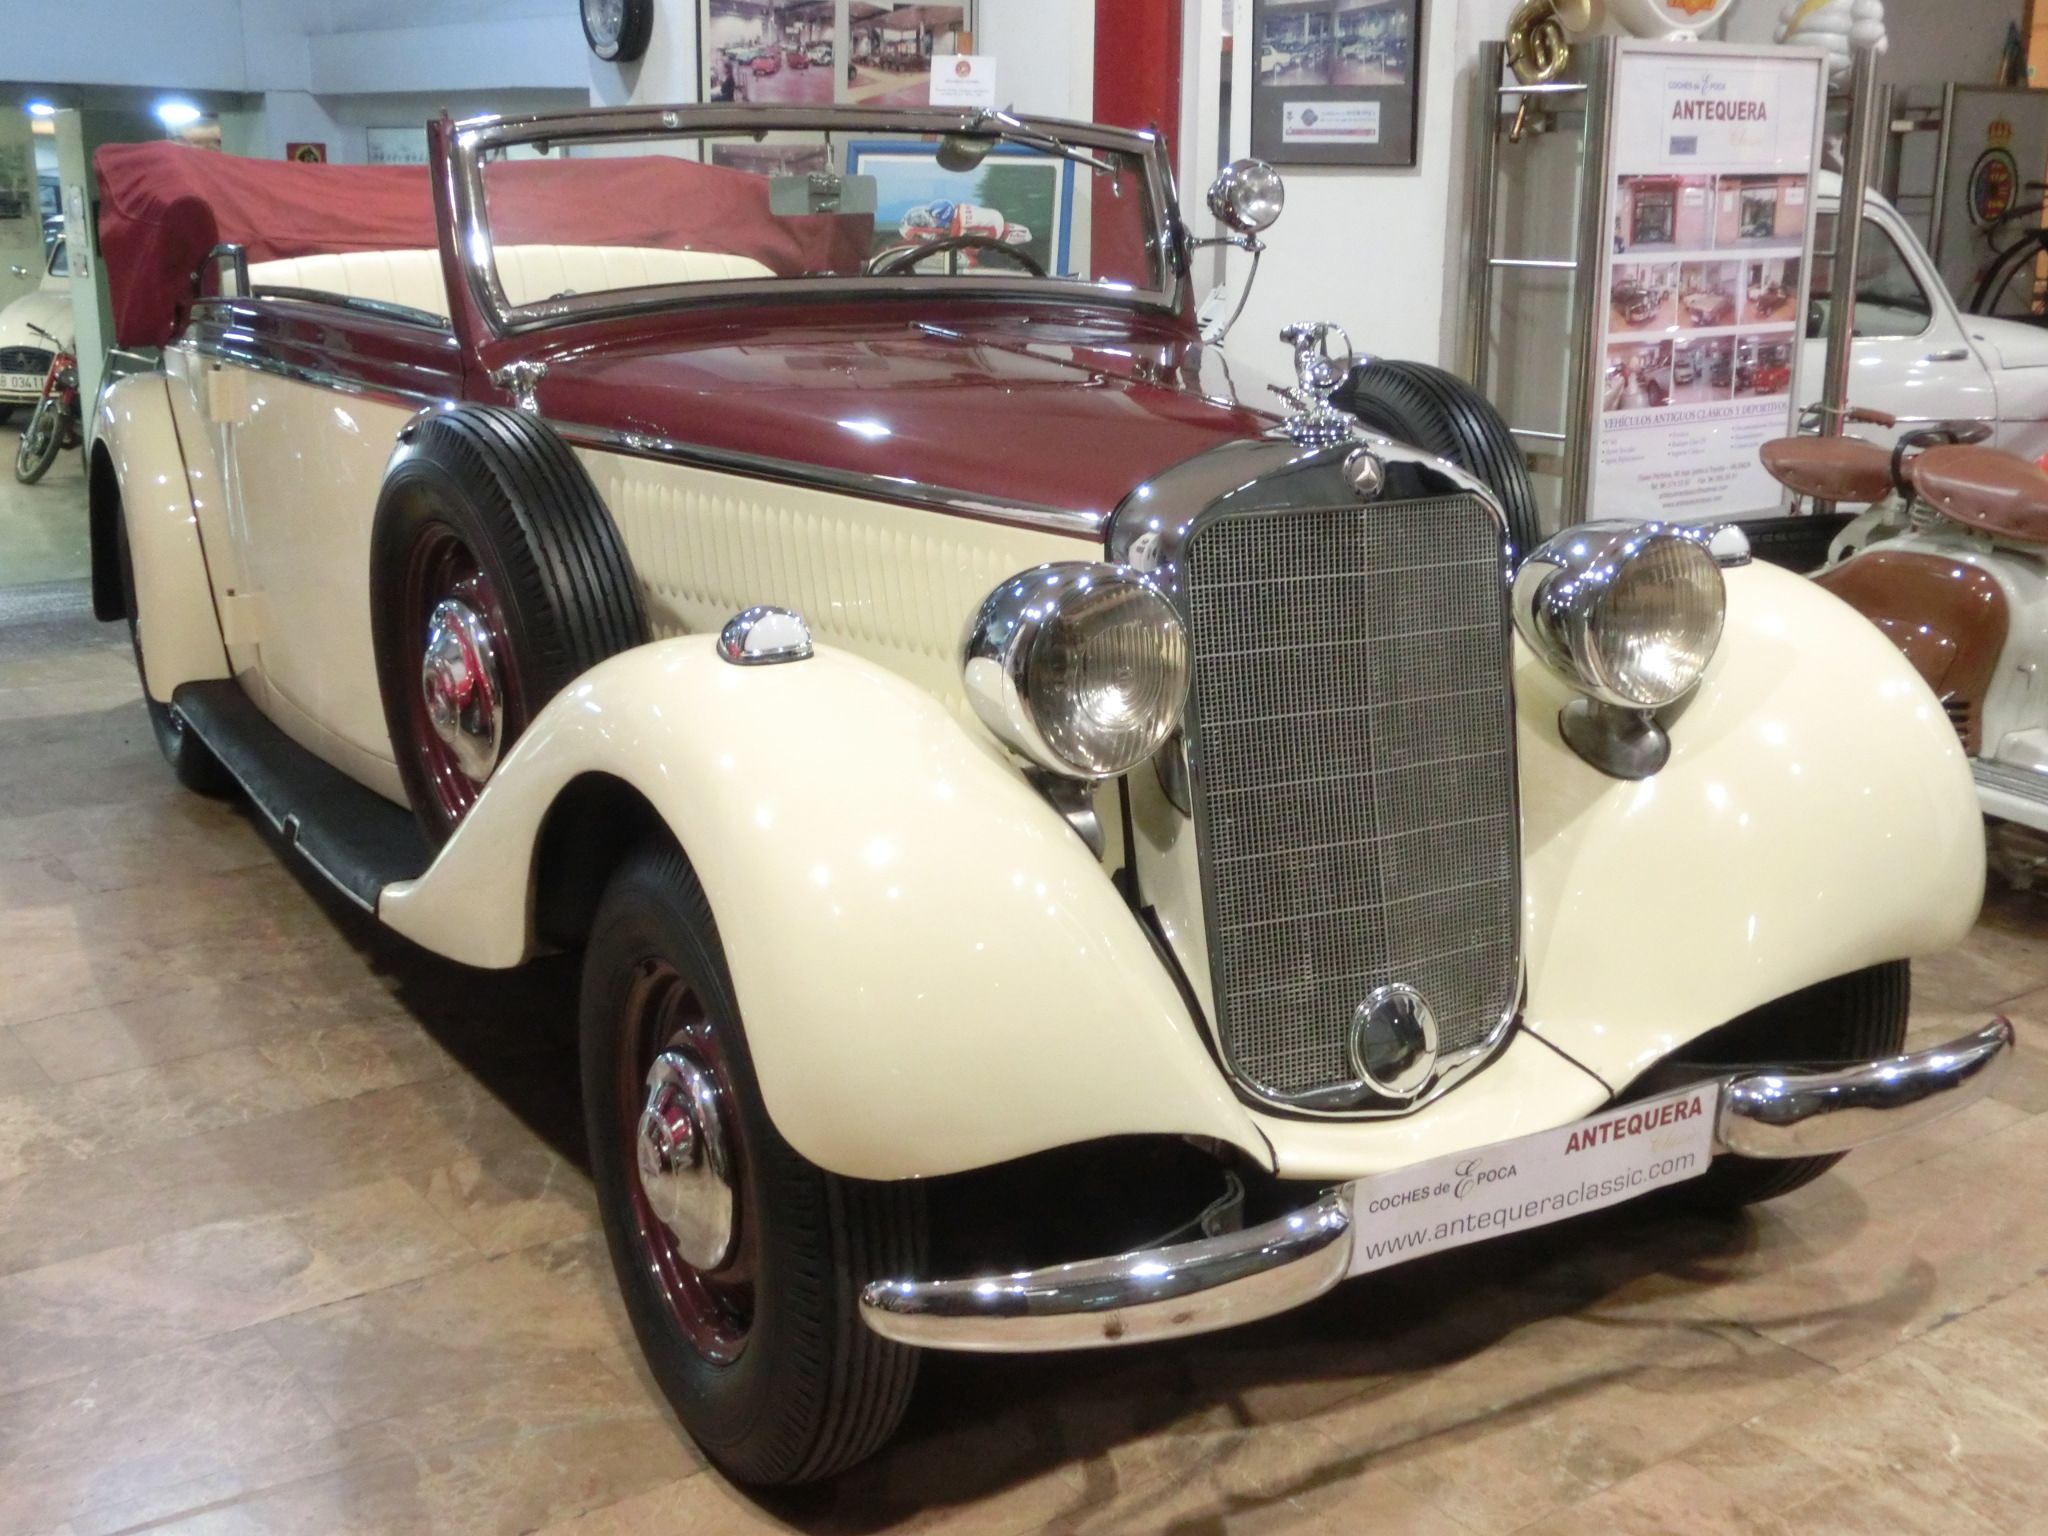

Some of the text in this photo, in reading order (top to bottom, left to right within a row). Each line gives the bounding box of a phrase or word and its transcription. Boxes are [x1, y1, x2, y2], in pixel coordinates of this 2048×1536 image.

[1672, 99, 1767, 121] ANTEQUERA
[1651, 410, 1696, 425] ANTIGUOS
[1741, 401, 1788, 416] DEPORTIVOS
[1565, 1096, 1702, 1155] ANTEQUERA
[1366, 1152, 1696, 1261] www.antequeraclassic.com
[1369, 1186, 1430, 1214] COCHES
[1433, 1181, 1450, 1198] de
